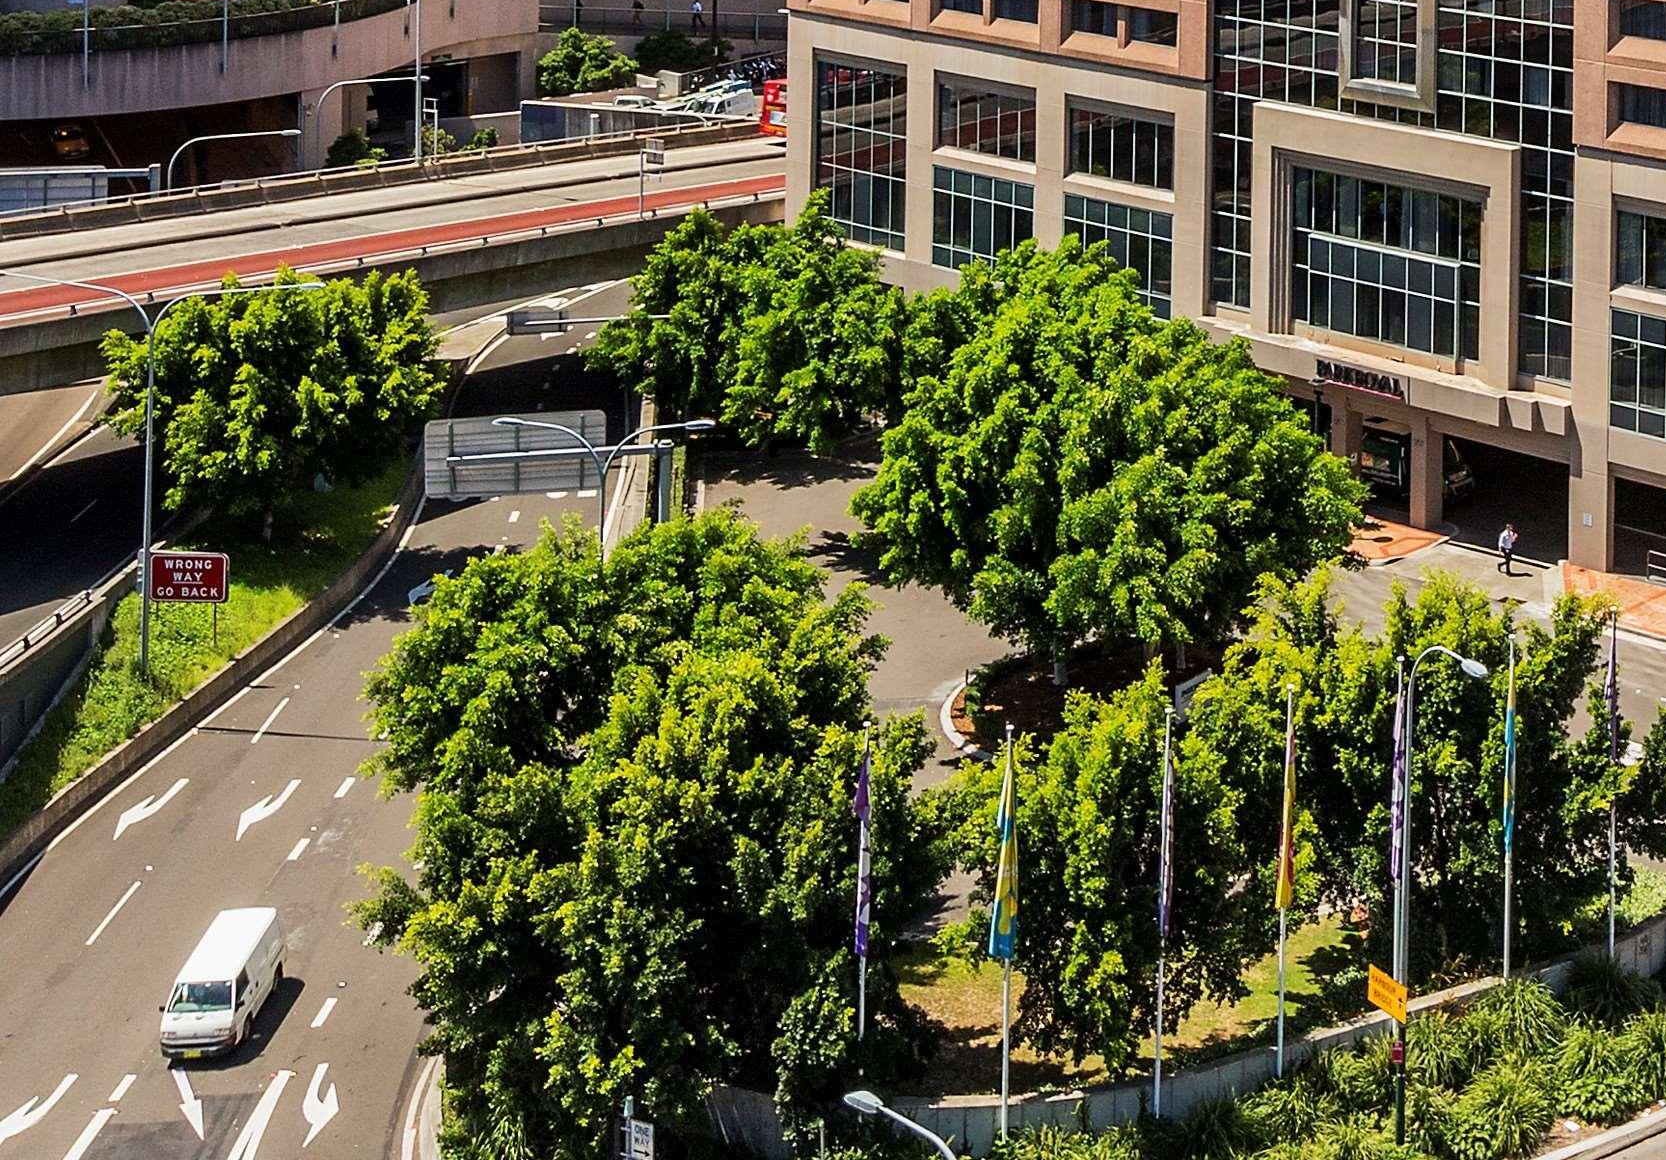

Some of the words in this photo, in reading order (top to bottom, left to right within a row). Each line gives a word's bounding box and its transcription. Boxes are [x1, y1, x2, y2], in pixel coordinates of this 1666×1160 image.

[1316, 359, 1404, 398] PARKROYAL
[164, 559, 212, 569] WRONG
[173, 572, 203, 581] WAY
[156, 586, 174, 597] GO
[181, 587, 218, 597] BACK
